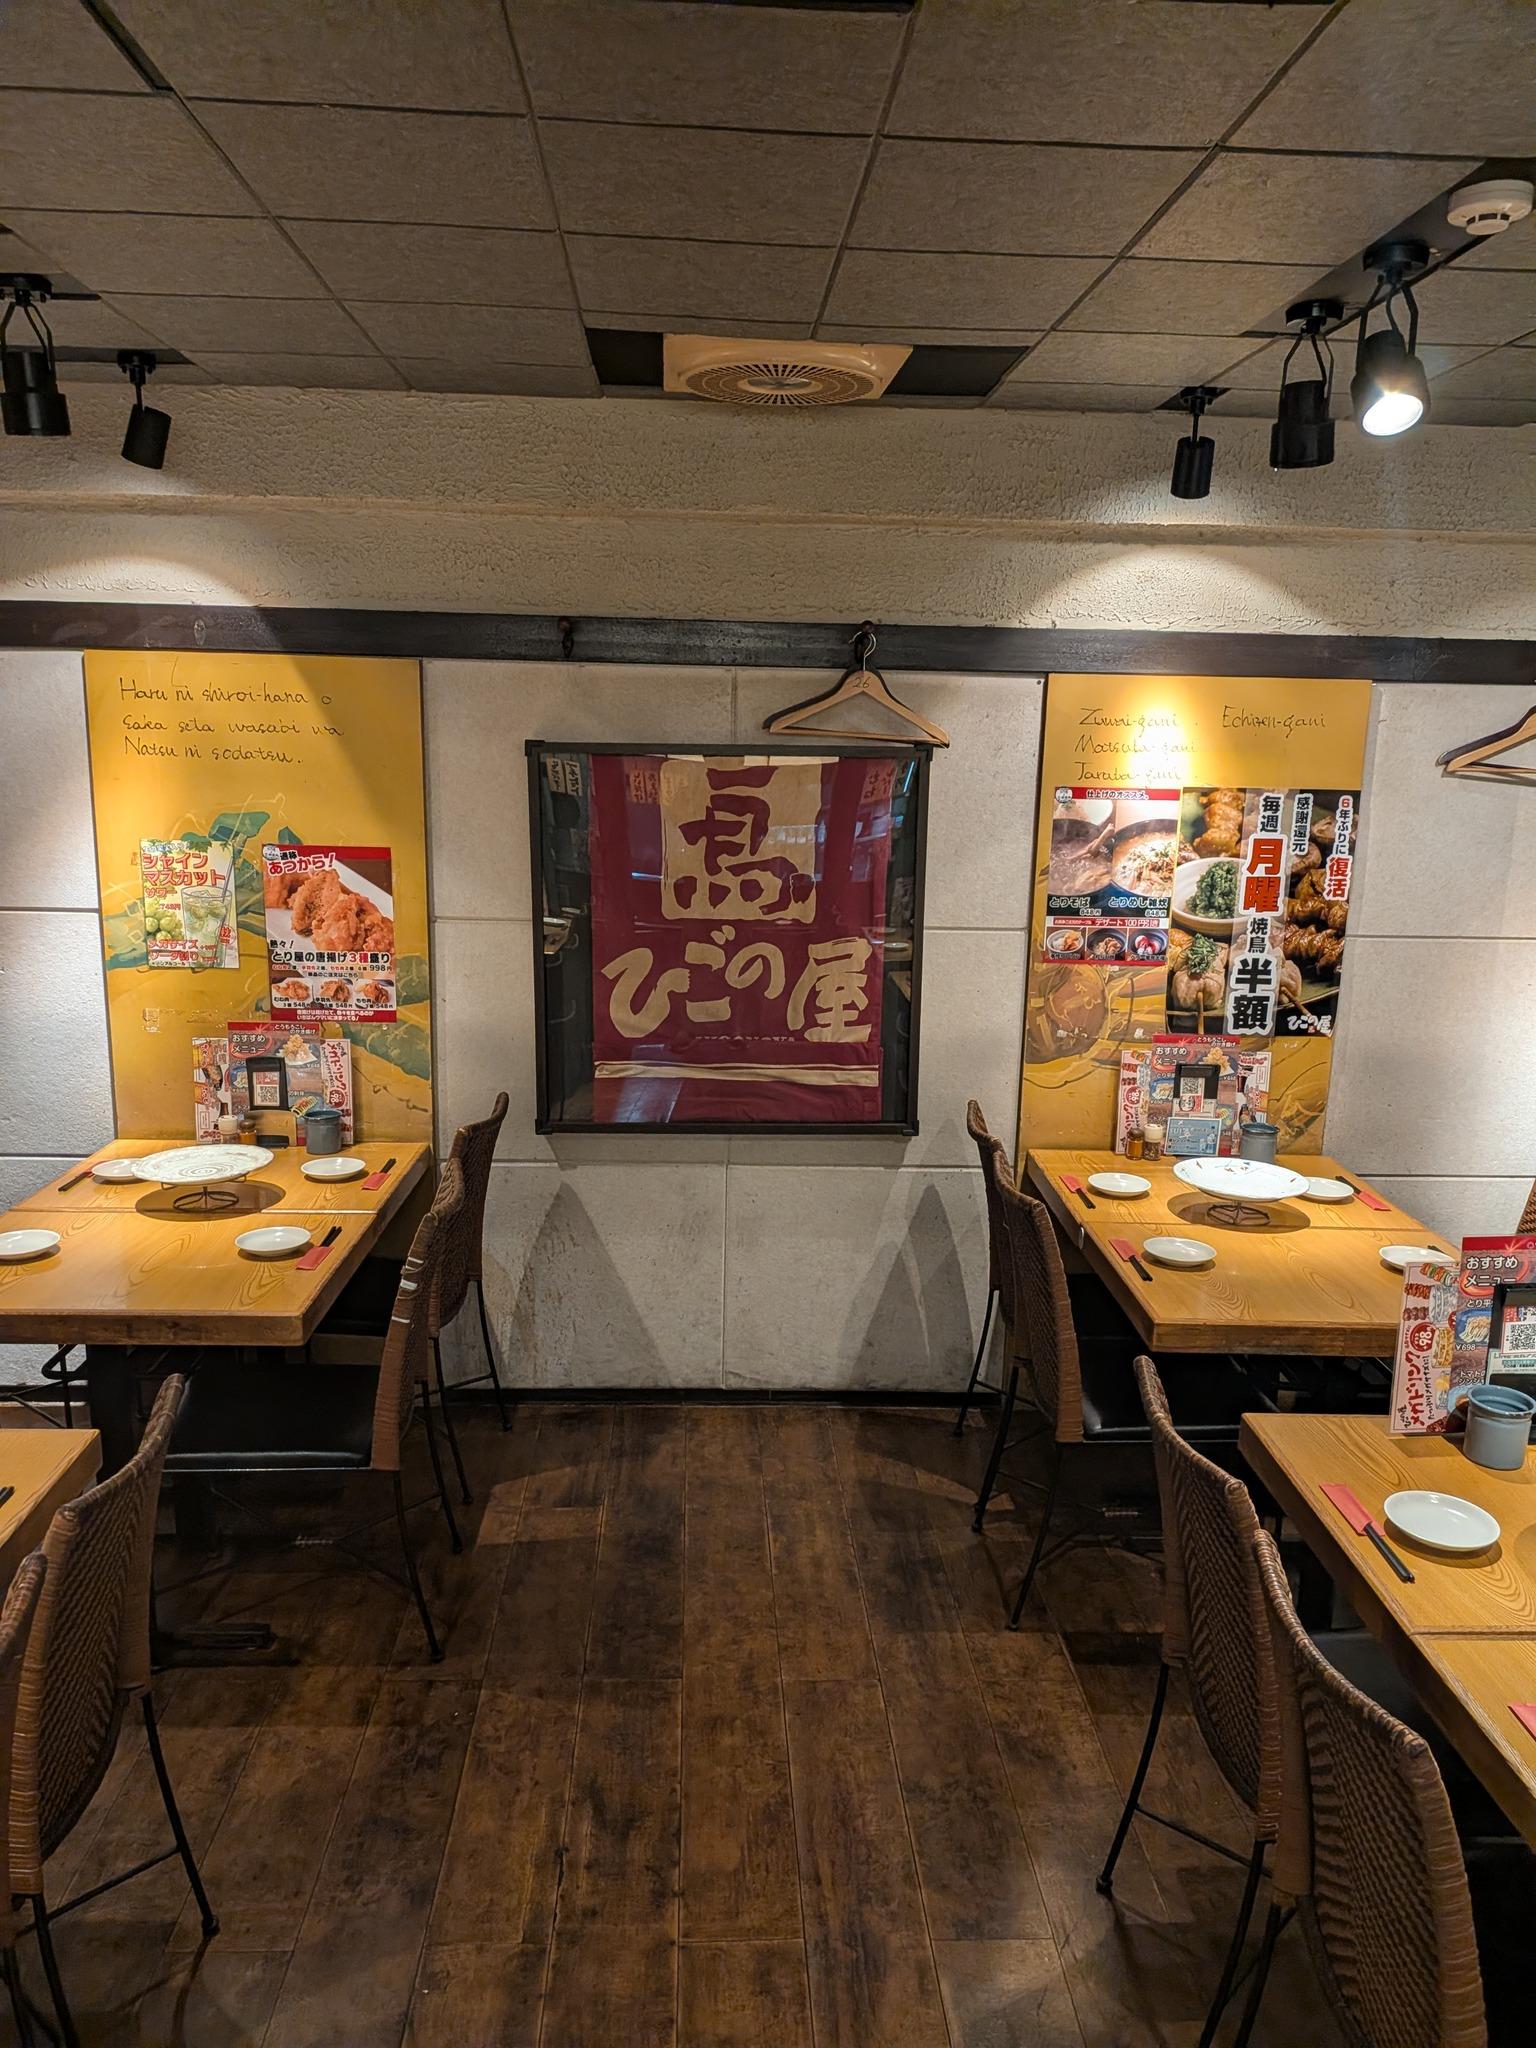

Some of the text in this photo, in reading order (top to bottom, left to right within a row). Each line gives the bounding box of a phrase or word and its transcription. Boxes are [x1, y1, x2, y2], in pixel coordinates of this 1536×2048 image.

[120, 677, 167, 700] Haru
[176, 685, 193, 701] ni
[321, 695, 332, 705] o
[1222, 705, 1326, 738] Echizen-gani
[124, 735, 178, 757] Natsu
[185, 744, 201, 758] ni
[1292, 796, 1311, 853] 感謝還元
[143, 852, 208, 870] シャイン
[143, 869, 226, 887] マスカット
[145, 887, 177, 898] サワー
[1050, 897, 1168, 909] とりそば とりめし雑炊
[601, 925, 872, 1043] ひごの屋
[232, 1034, 266, 1043] おすすめ
[232, 1045, 266, 1053] メニュー
[1156, 1047, 1187, 1055] おすすめ
[327, 1043, 347, 1091] メガドリンク
[1156, 1057, 1187, 1065] メニュー
[1466, 1256, 1518, 1270] おすすめ
[1466, 1276, 1517, 1288] メニュー
[1404, 1351, 1425, 1427] メガドリンク
